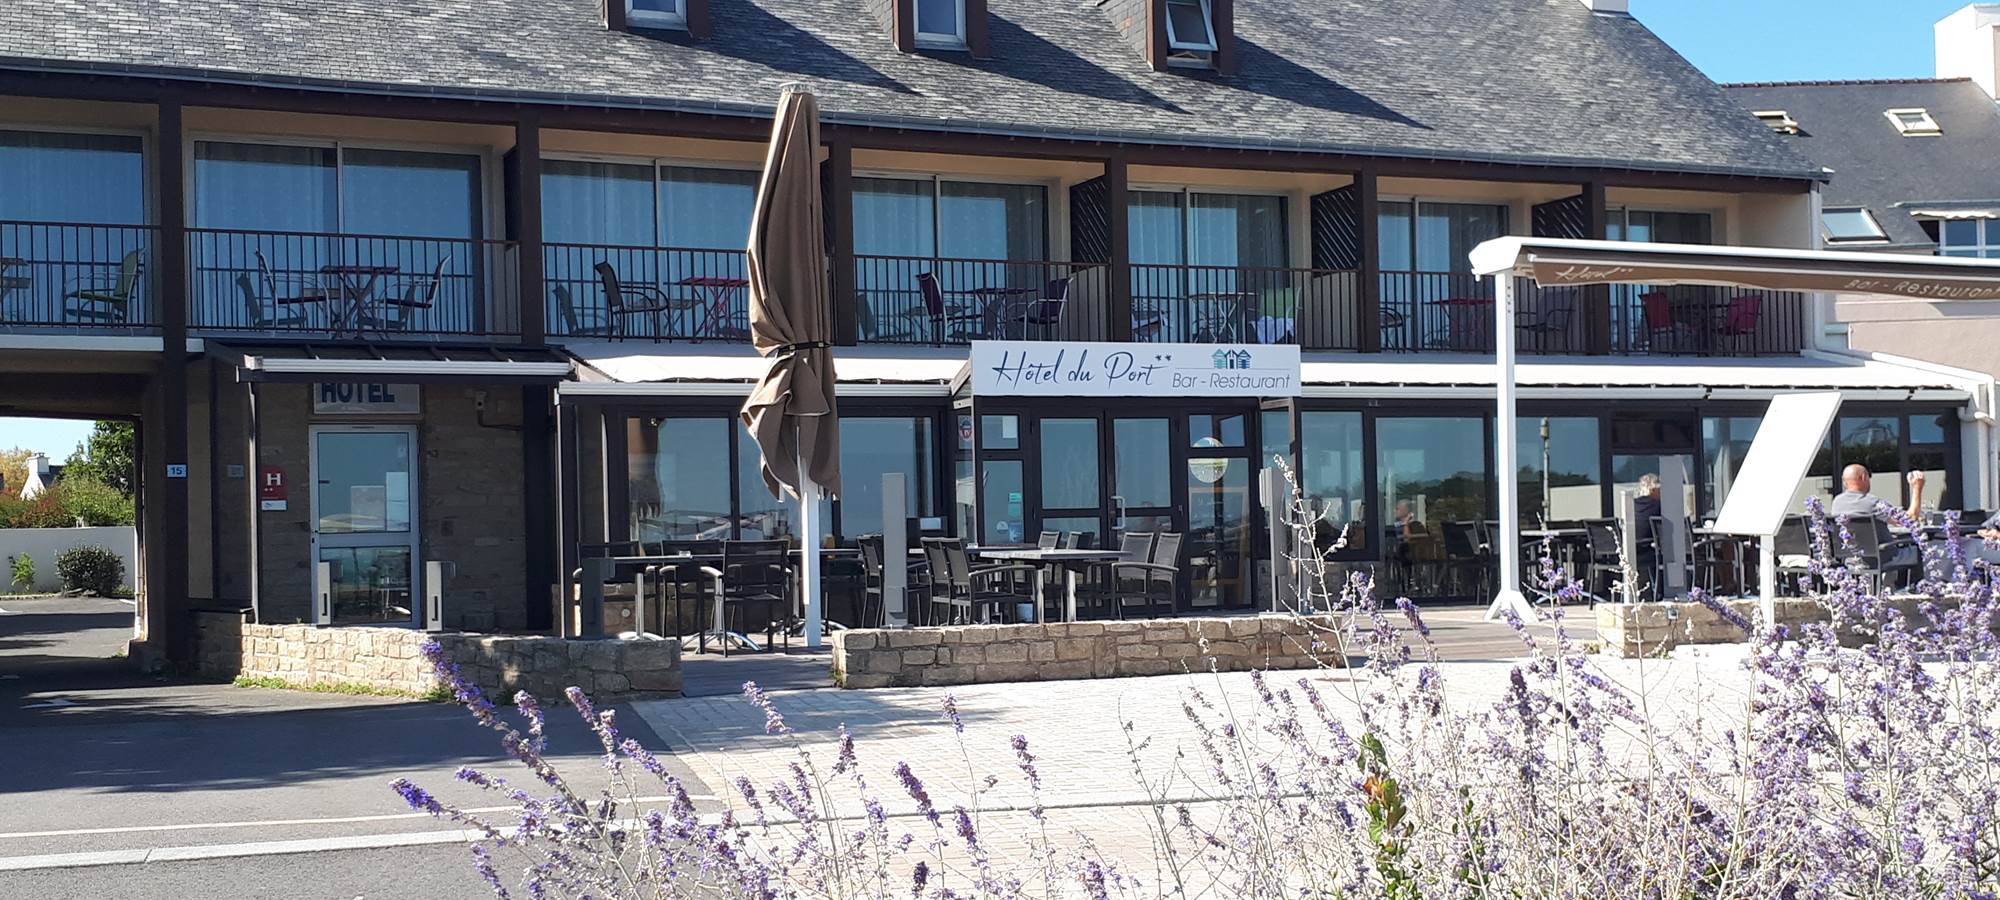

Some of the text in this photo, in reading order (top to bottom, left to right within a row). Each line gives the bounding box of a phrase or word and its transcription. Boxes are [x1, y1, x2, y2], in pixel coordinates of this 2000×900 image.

[992, 349, 1168, 390] Hôtel du Port
[1172, 372, 1198, 388] Bar
[1209, 372, 1290, 388] Restaurant
[171, 466, 183, 475] 15
[267, 473, 281, 486] H
